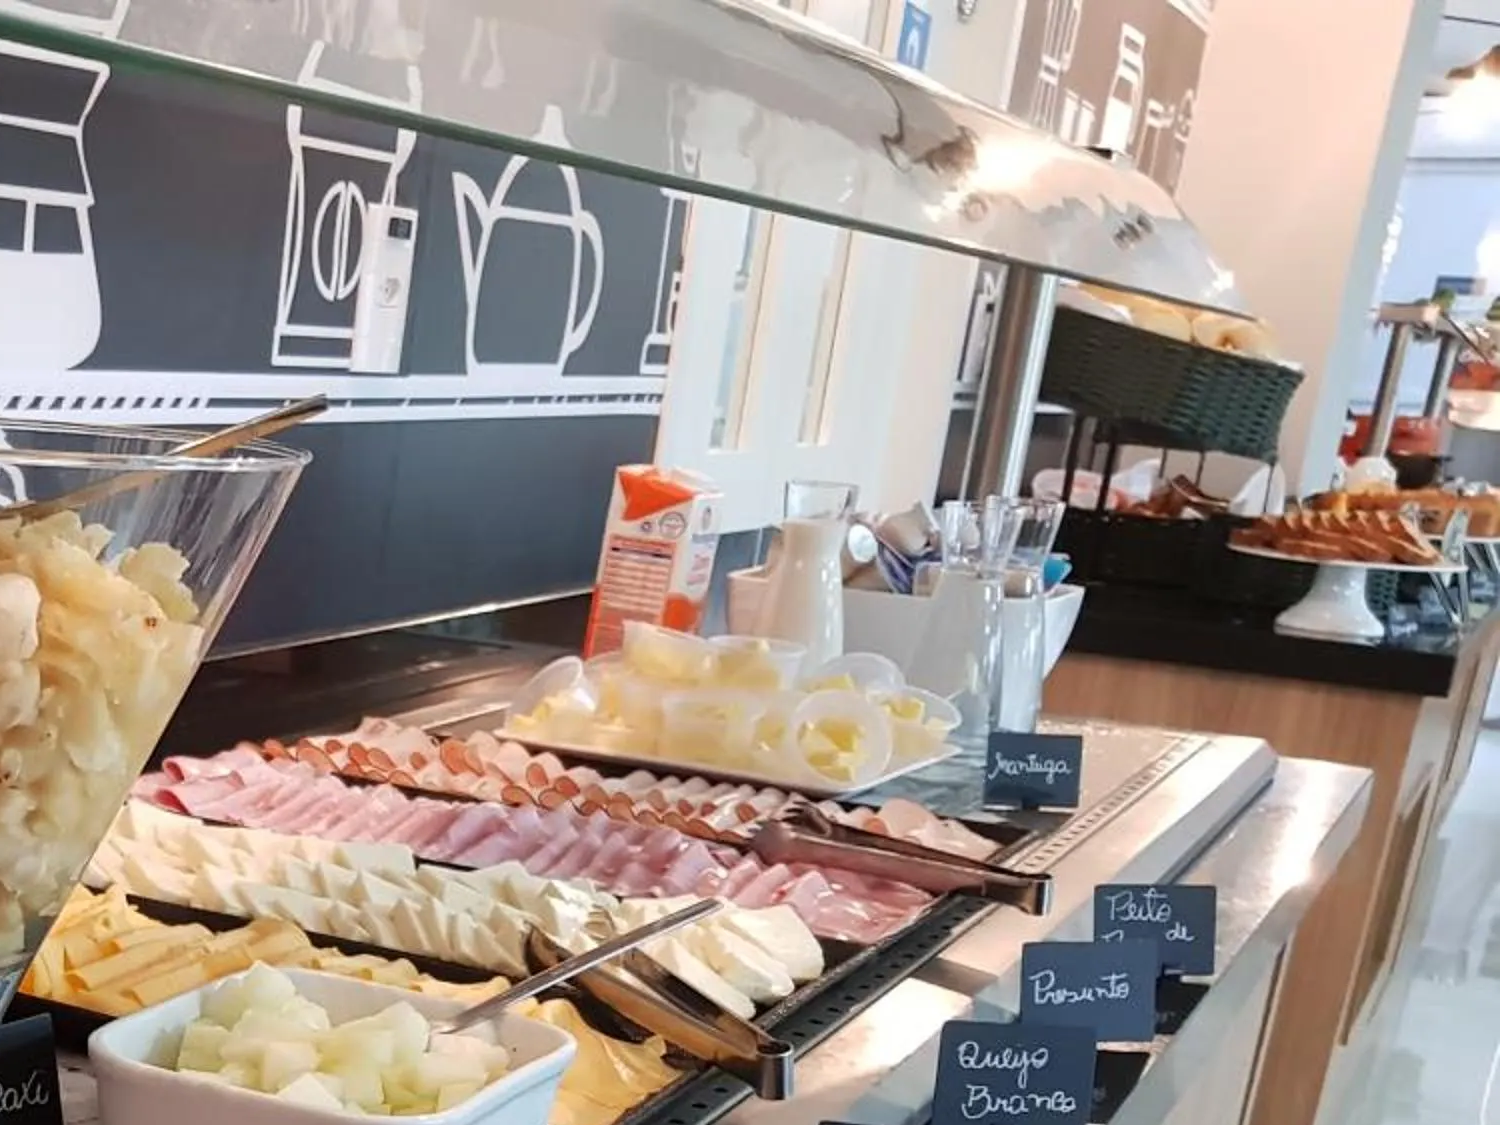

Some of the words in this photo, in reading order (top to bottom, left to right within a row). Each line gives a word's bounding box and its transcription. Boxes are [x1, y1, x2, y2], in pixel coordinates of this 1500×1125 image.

[1104, 887, 1172, 922] Peito
[1165, 922, 1195, 942] de
[1028, 969, 1131, 1005] Presunto
[957, 1041, 1049, 1089] Queijo
[961, 1084, 1077, 1119] Branco
